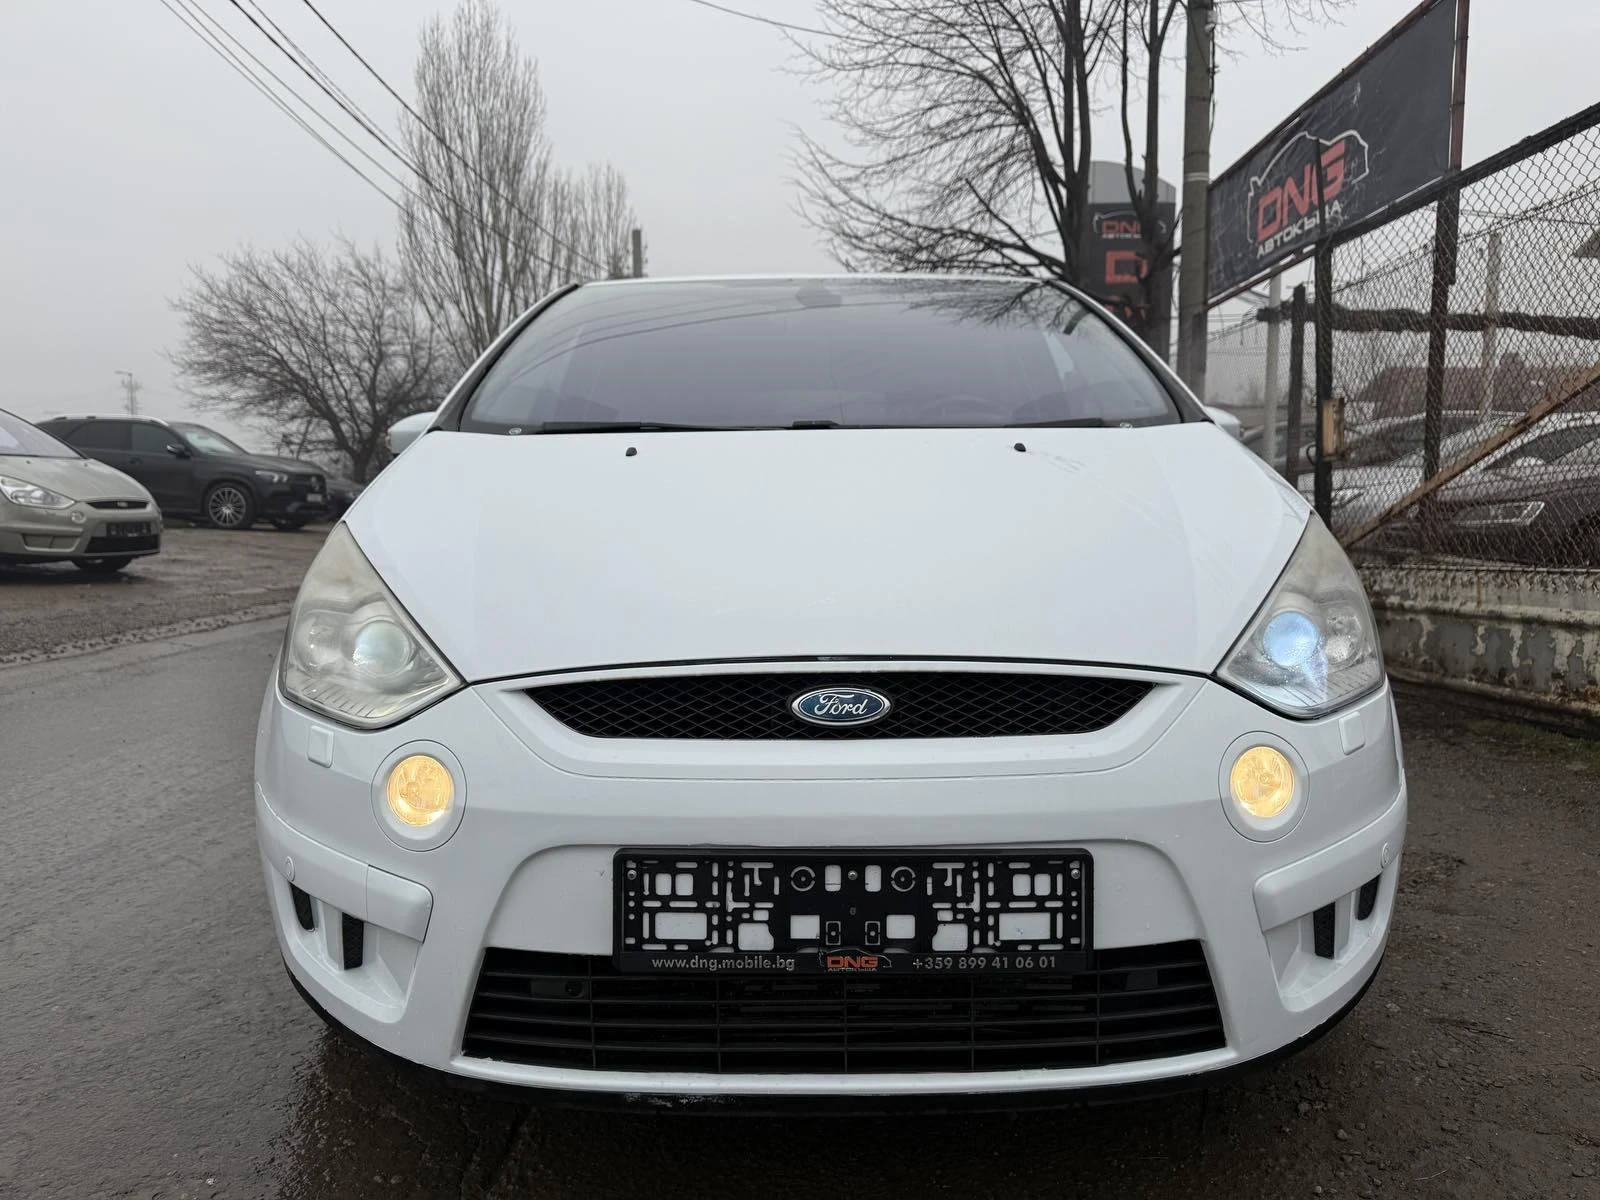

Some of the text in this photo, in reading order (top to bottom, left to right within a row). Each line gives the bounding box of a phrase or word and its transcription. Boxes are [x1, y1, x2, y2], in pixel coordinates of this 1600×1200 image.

[1256, 140, 1345, 244] DNG
[1102, 220, 1142, 234] DN
[814, 693, 869, 716] Ford
[651, 955, 796, 972] www.dng.mobile.bg
[827, 956, 879, 968] DNG
[912, 956, 1056, 969] +359 899 41 06 01
